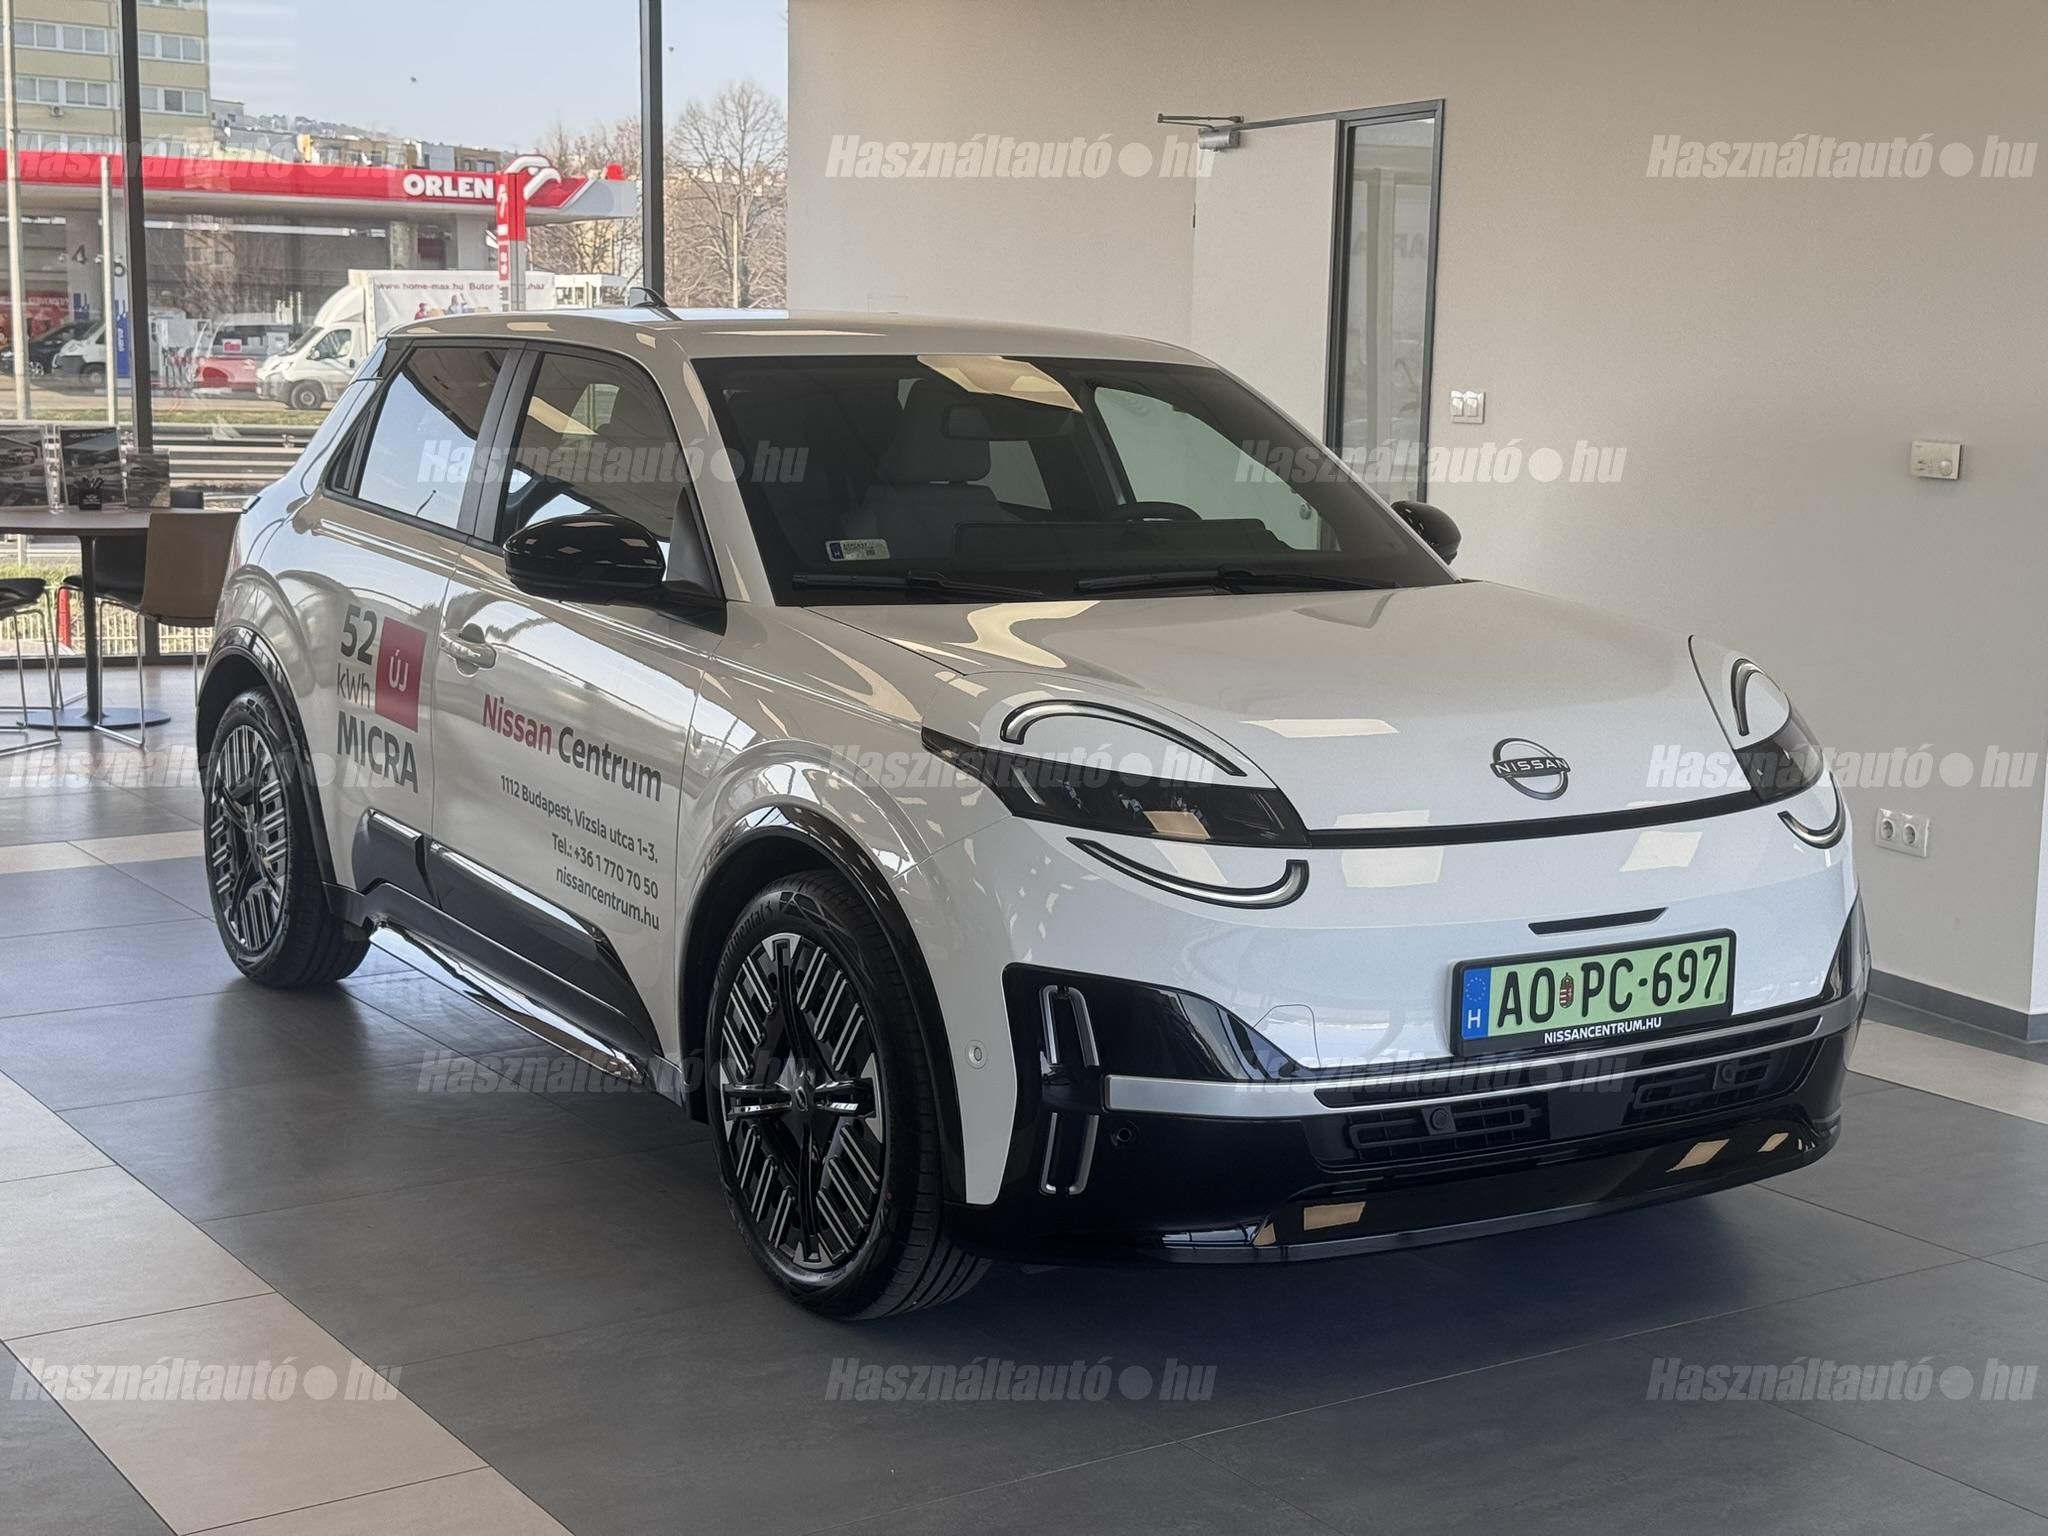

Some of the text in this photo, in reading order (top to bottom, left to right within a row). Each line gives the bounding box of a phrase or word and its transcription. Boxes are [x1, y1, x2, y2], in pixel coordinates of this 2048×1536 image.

[403, 173, 494, 199] ORLEN
[340, 603, 378, 666] 52
[336, 663, 371, 709] kWh
[388, 648, 409, 692] ÚJ
[337, 710, 419, 794] MICRA
[482, 694, 662, 802] Nissan Centrum
[1494, 759, 1569, 774] NISSAN
[501, 775, 520, 798] 1112
[522, 785, 573, 827] Budapest,
[610, 827, 634, 852] utca
[637, 837, 659, 864] 1-3.
[552, 832, 659, 900] Tel.: +36 1 770 70 50
[556, 866, 660, 931] nissancentrum.hu
[1467, 1008, 1481, 1029] H
[1544, 1016, 1662, 1044] NISSANCENTRUM.HU
